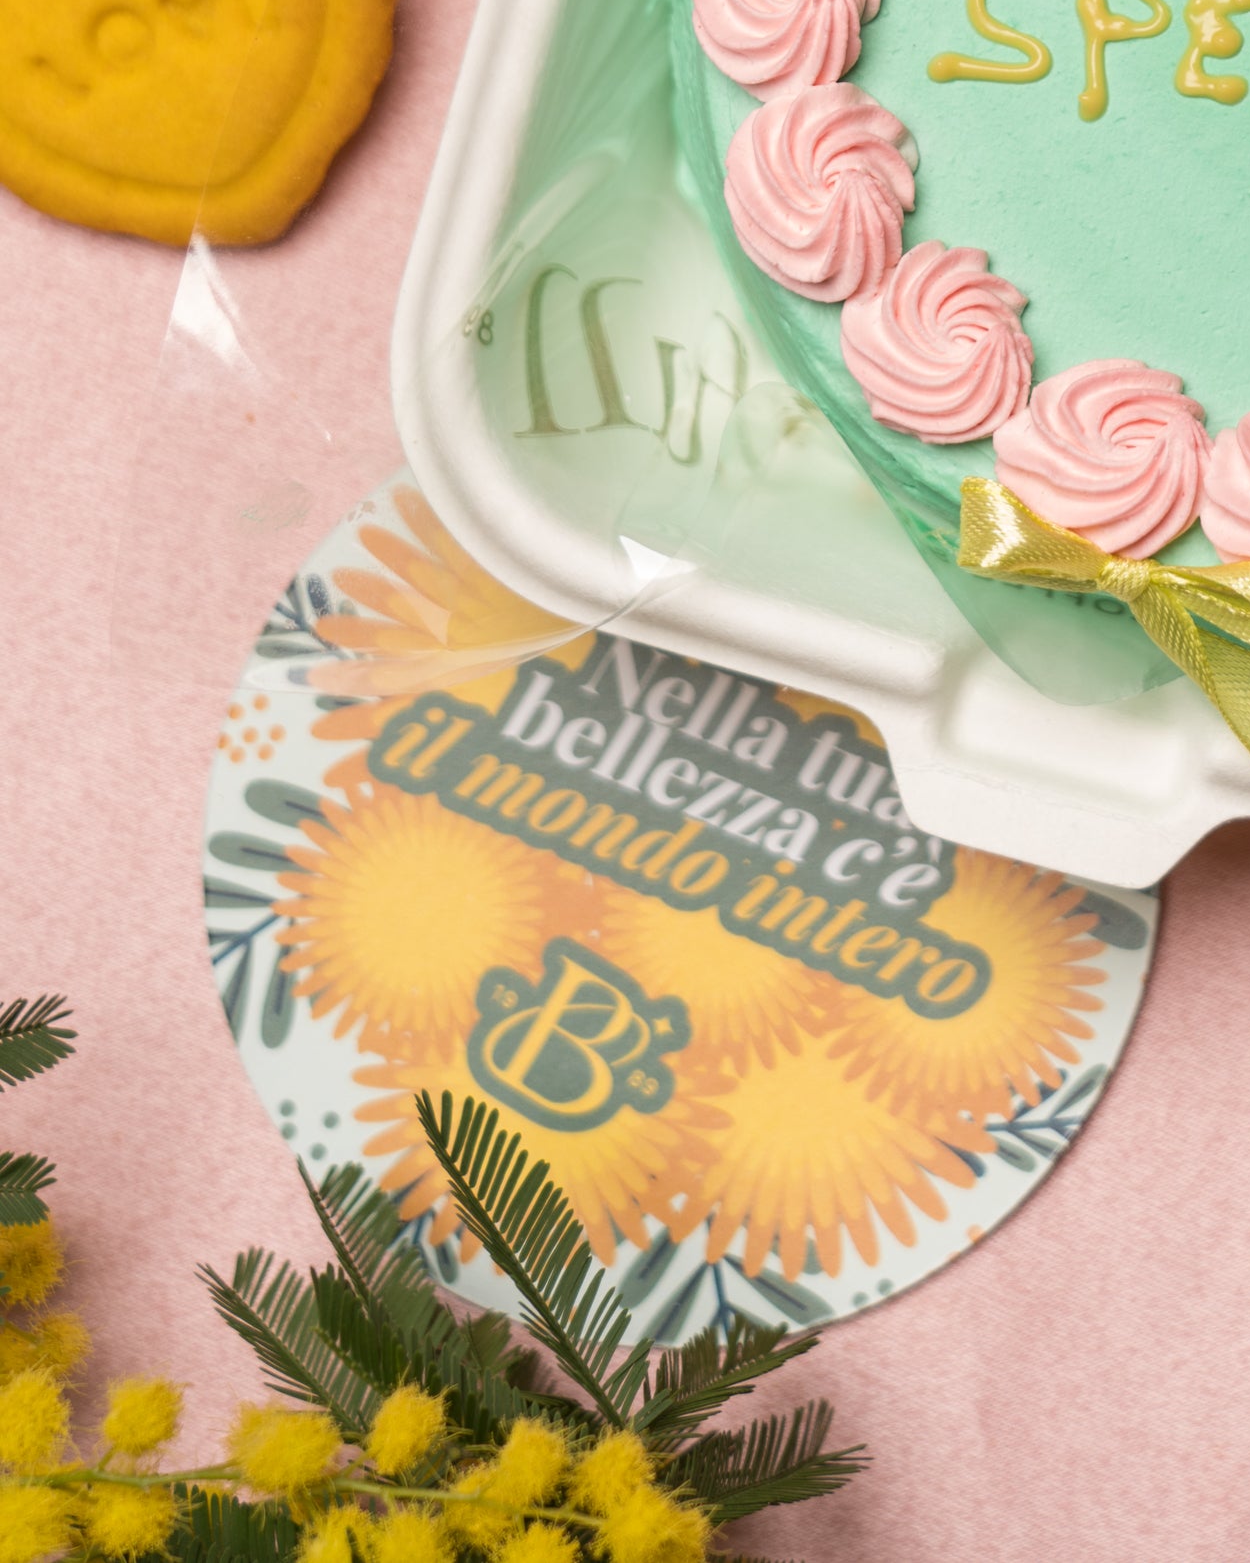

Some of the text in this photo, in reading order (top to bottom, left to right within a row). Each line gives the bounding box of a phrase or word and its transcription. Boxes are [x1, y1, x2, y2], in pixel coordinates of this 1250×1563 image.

[500, 669, 820, 863] bellezza
[579, 637, 789, 770] Nella
[380, 707, 978, 1005] il mondo intero
[482, 954, 650, 1116] B
